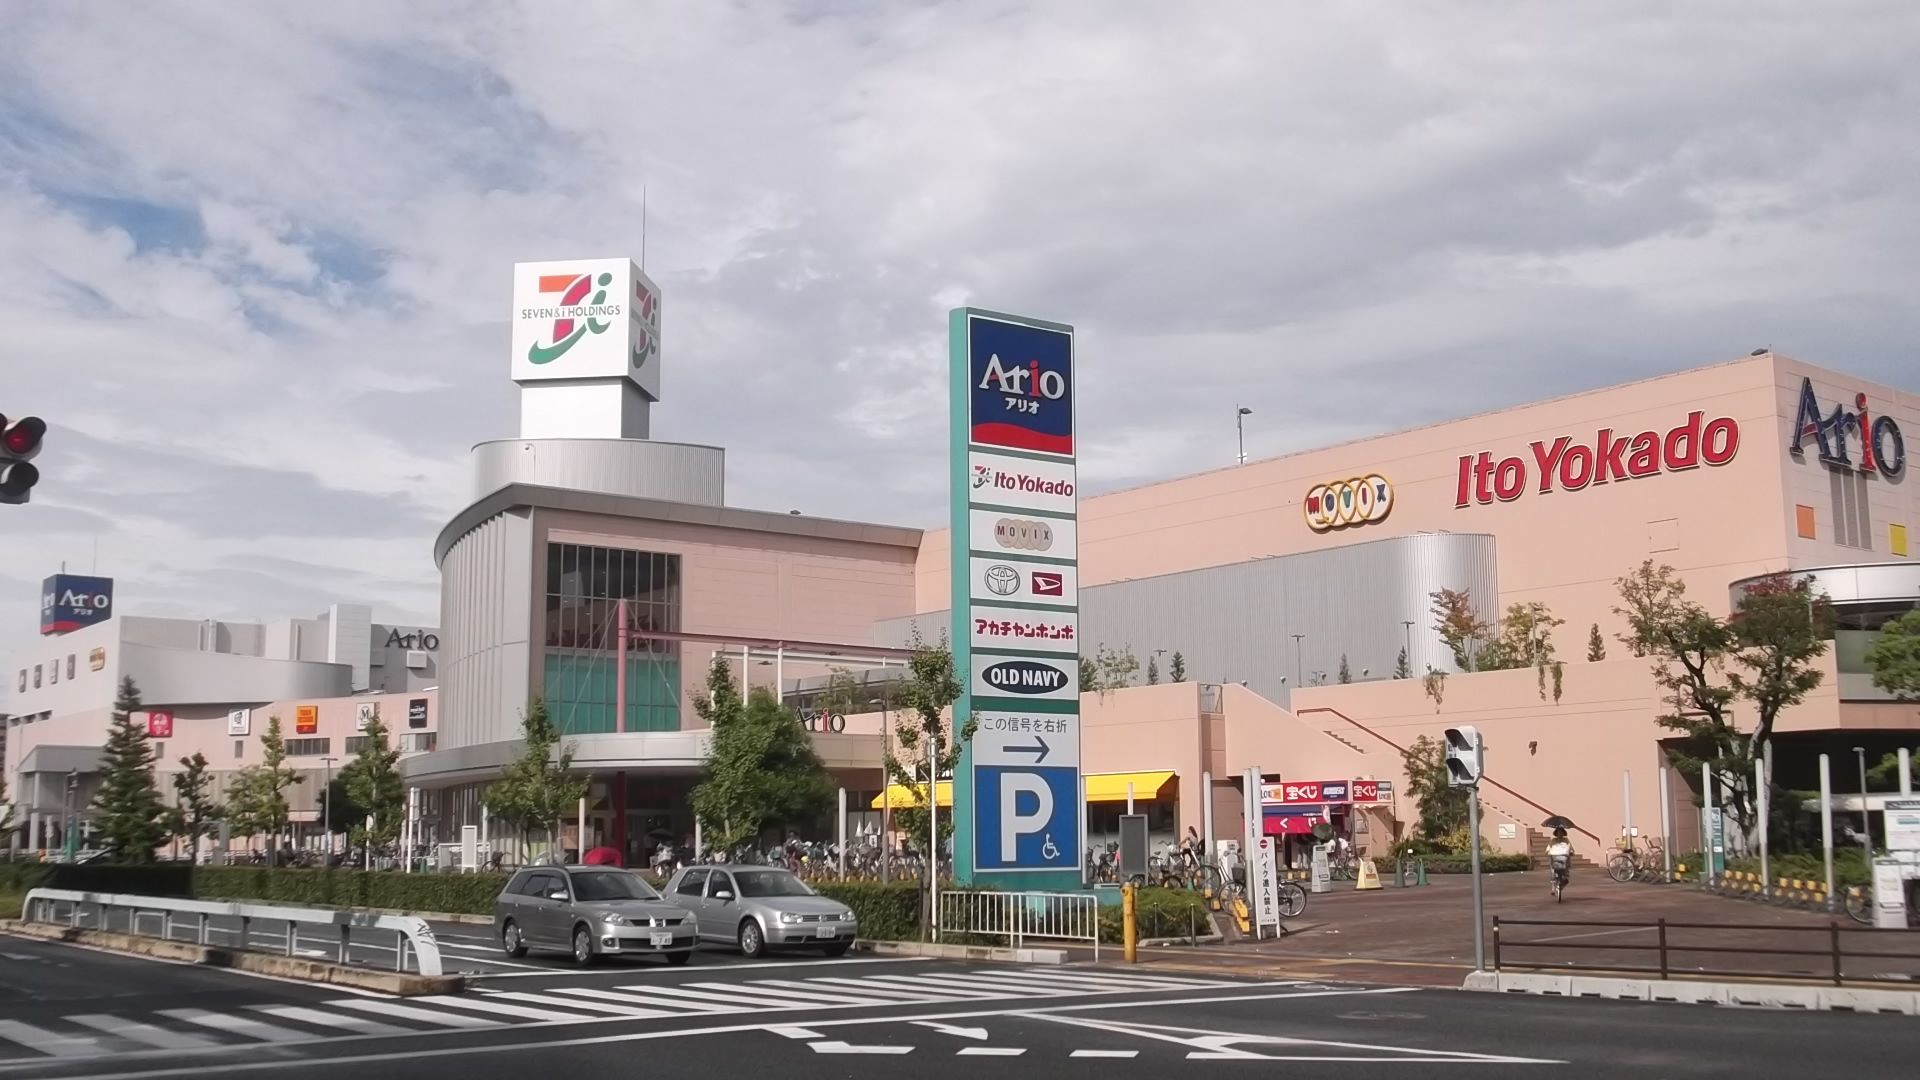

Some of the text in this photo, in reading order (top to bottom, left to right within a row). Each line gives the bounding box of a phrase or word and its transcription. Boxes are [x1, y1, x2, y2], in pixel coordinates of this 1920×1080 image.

[567, 305, 621, 317] HOLDINGS
[979, 353, 1065, 400] Ario
[1005, 397, 1040, 414] アリオ
[1788, 376, 1906, 477] Ario
[1455, 409, 1741, 509] Ito Yokado
[994, 471, 1074, 497] Ito Yokado
[1307, 483, 1387, 515] MOVIX
[997, 525, 1050, 541] MOVIX
[58, 588, 110, 609] Ario
[384, 627, 440, 650] Ario
[990, 667, 1061, 688] OLD NAVY
[984, 717, 1068, 734] この信号を右折
[1286, 786, 1318, 800] 宝くじ
[1353, 785, 1377, 797] 宝くじ
[1001, 772, 1054, 862] P
[1260, 852, 1272, 915] バイク進入禁止
